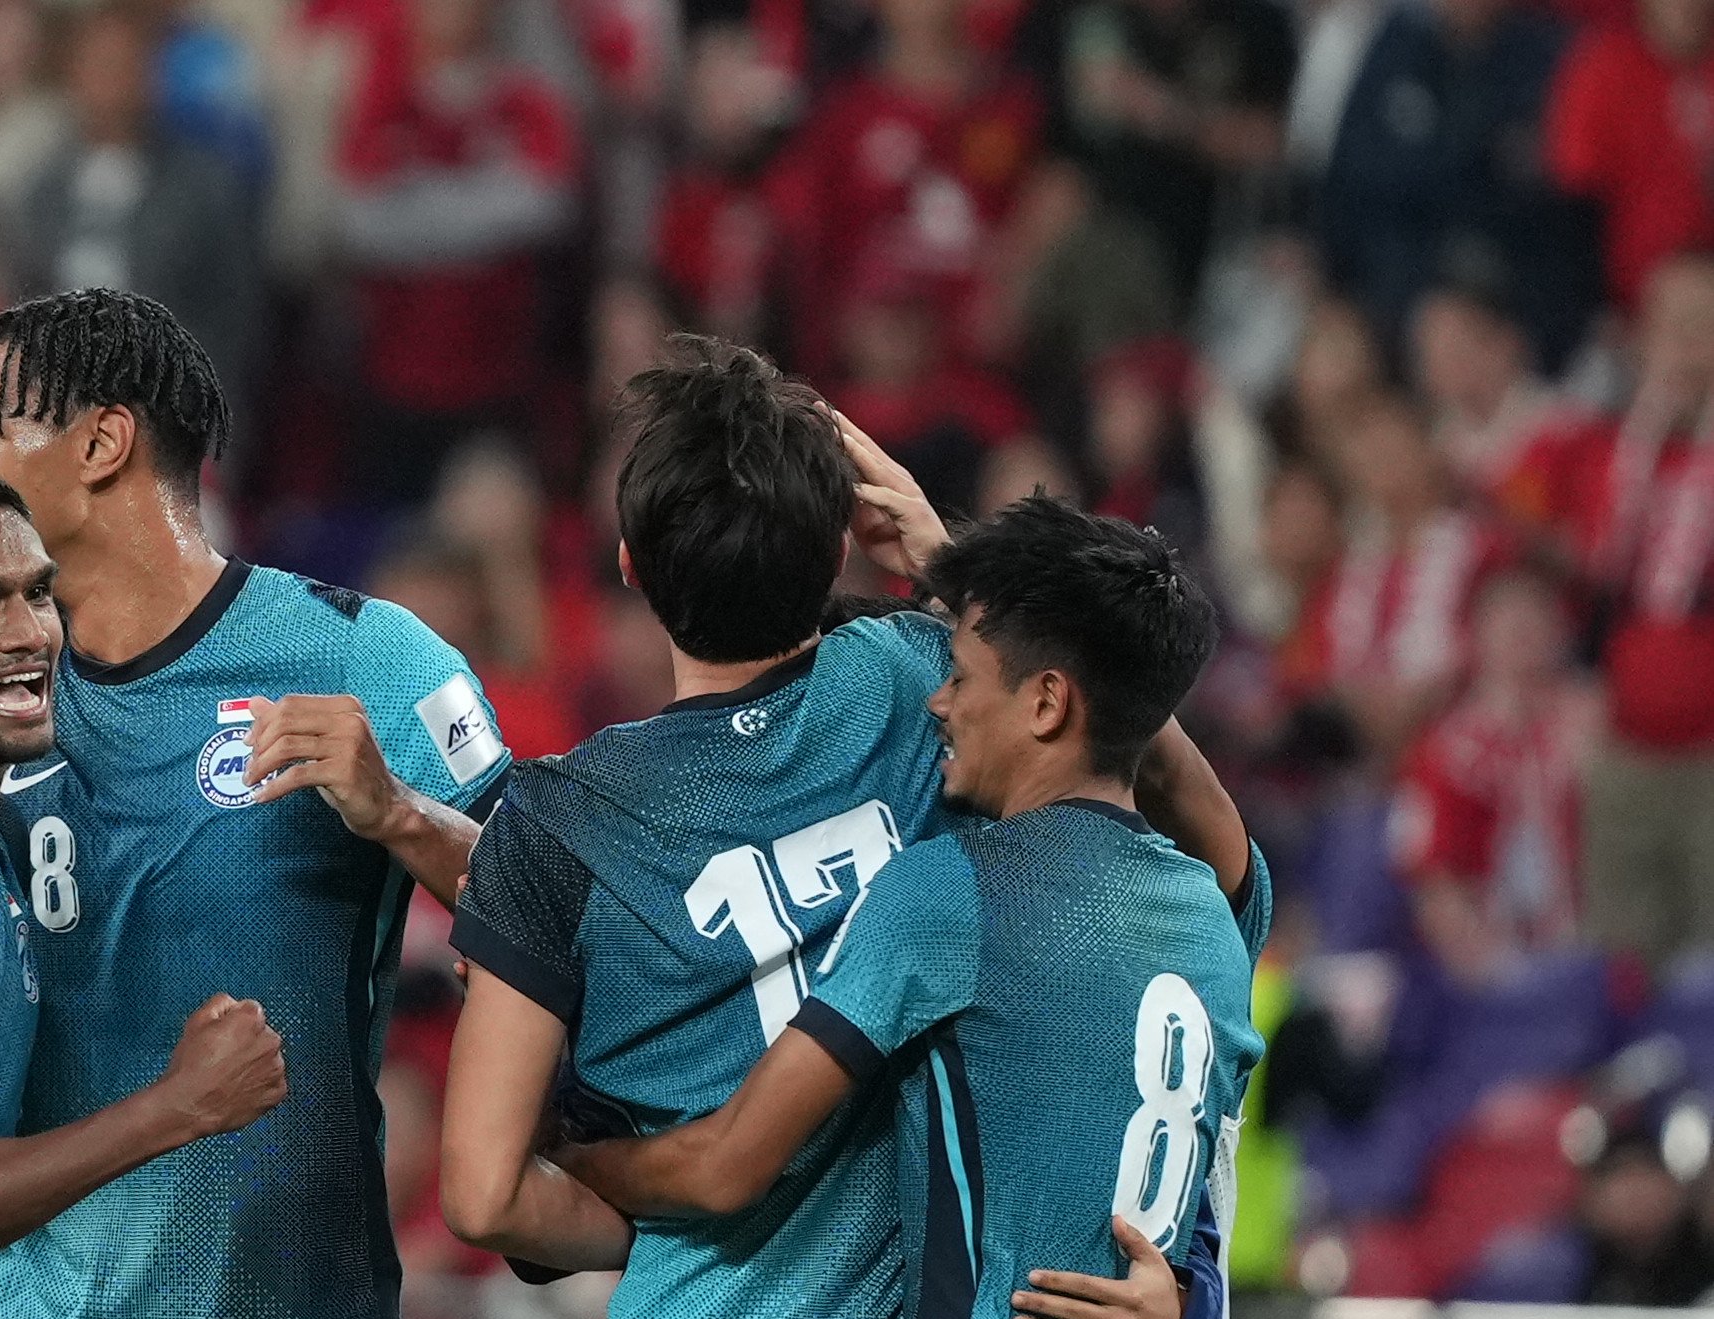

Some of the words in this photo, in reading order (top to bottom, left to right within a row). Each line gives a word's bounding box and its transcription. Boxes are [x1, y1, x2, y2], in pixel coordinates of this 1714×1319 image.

[199, 735, 227, 780] FOOTBALL
[447, 705, 481, 749] AFC
[683, 798, 904, 1049] 17
[1111, 972, 1215, 1258] 8
